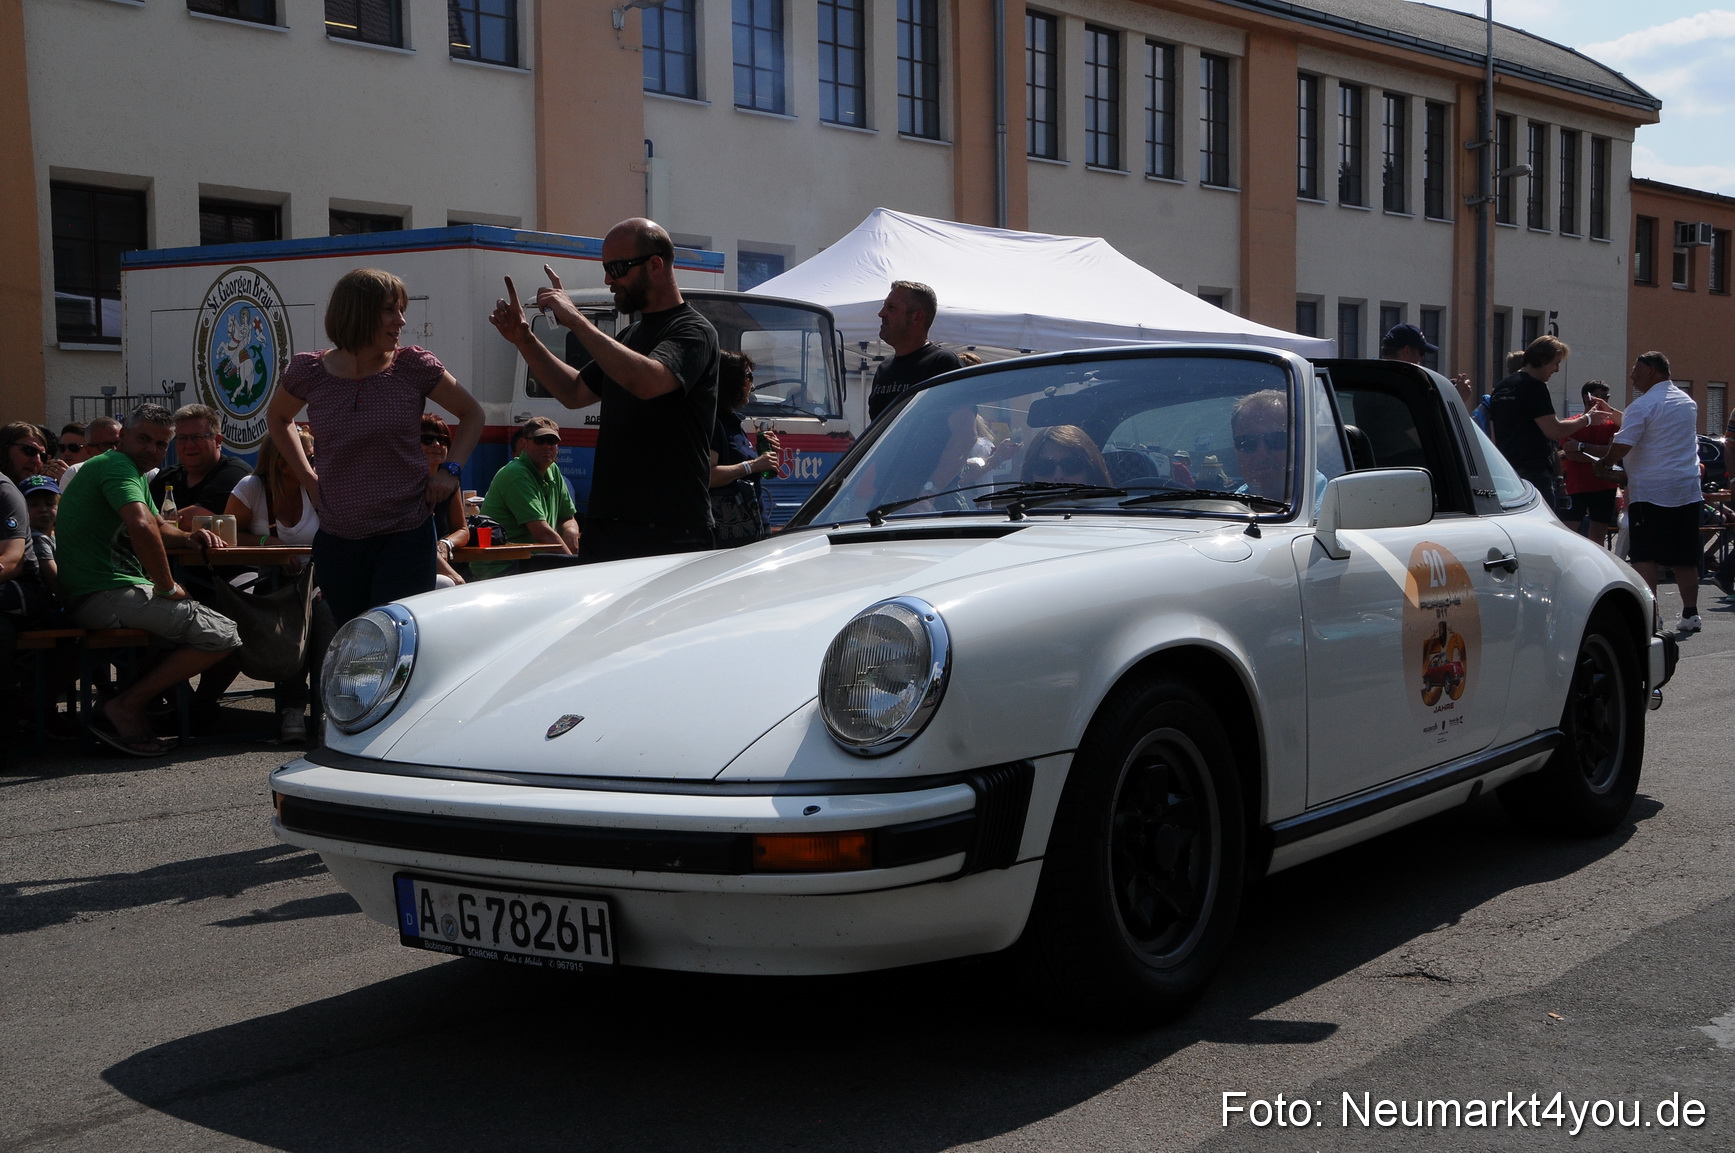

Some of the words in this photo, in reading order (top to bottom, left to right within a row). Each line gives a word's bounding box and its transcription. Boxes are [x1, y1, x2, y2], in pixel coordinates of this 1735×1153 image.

[206, 297, 222, 316] St.
[218, 275, 252, 302] Georgen
[252, 275, 273, 311] Bräu
[1548, 310, 1559, 338] 5
[221, 413, 268, 443] Buttenheim
[777, 447, 823, 480] Bier
[1422, 549, 1447, 588] 20
[1434, 702, 1454, 714] JAHRE
[424, 939, 453, 954] Bobingen
[467, 948, 498, 961] SCHACHER
[556, 960, 584, 972] 967915
